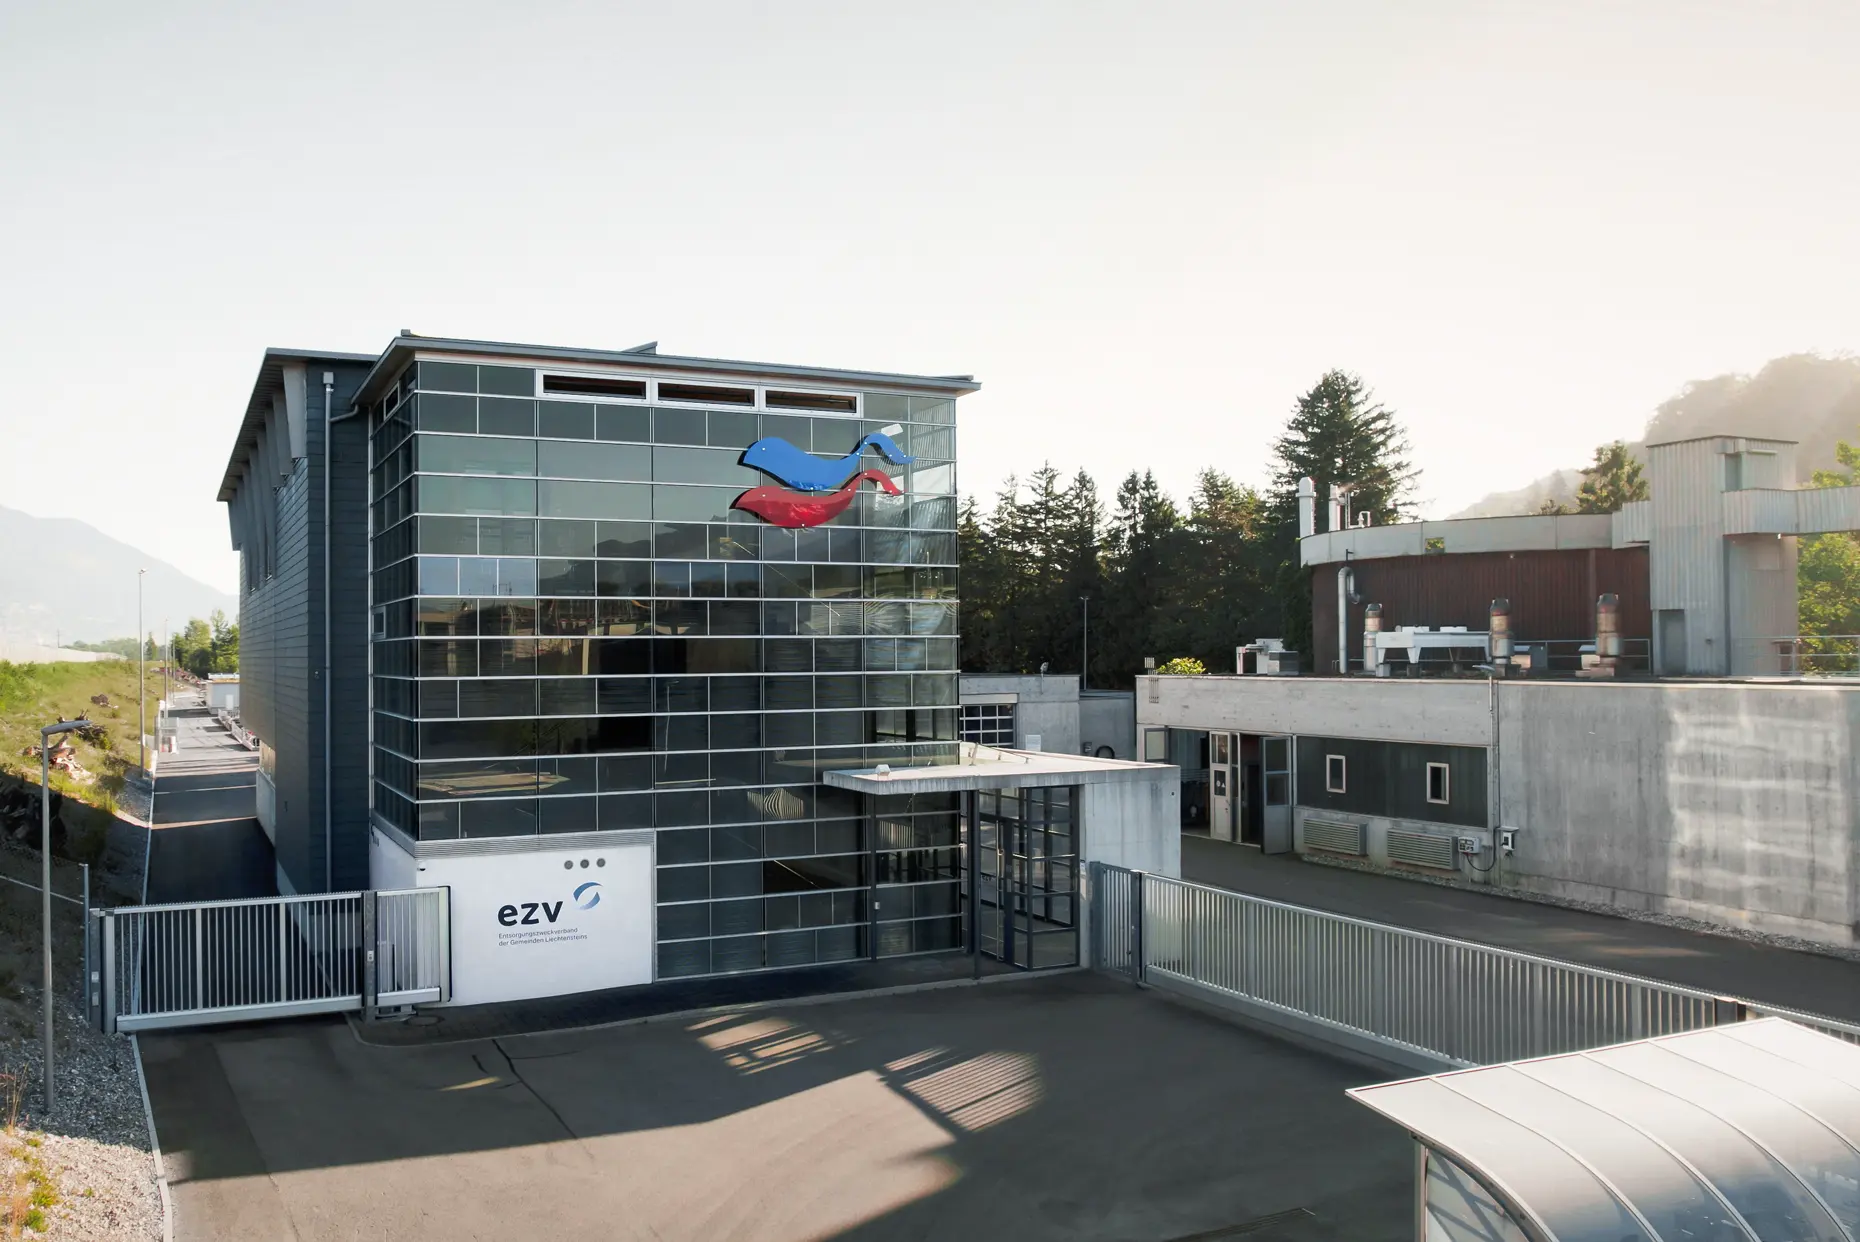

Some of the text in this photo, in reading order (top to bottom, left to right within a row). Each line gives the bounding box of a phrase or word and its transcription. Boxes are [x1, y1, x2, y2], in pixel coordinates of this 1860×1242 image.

[498, 901, 563, 926] ezv
[498, 928, 578, 939] Entsorgungszweckverband
[510, 937, 545, 946] Gemeinden
[545, 934, 588, 943] Liechtensteins
